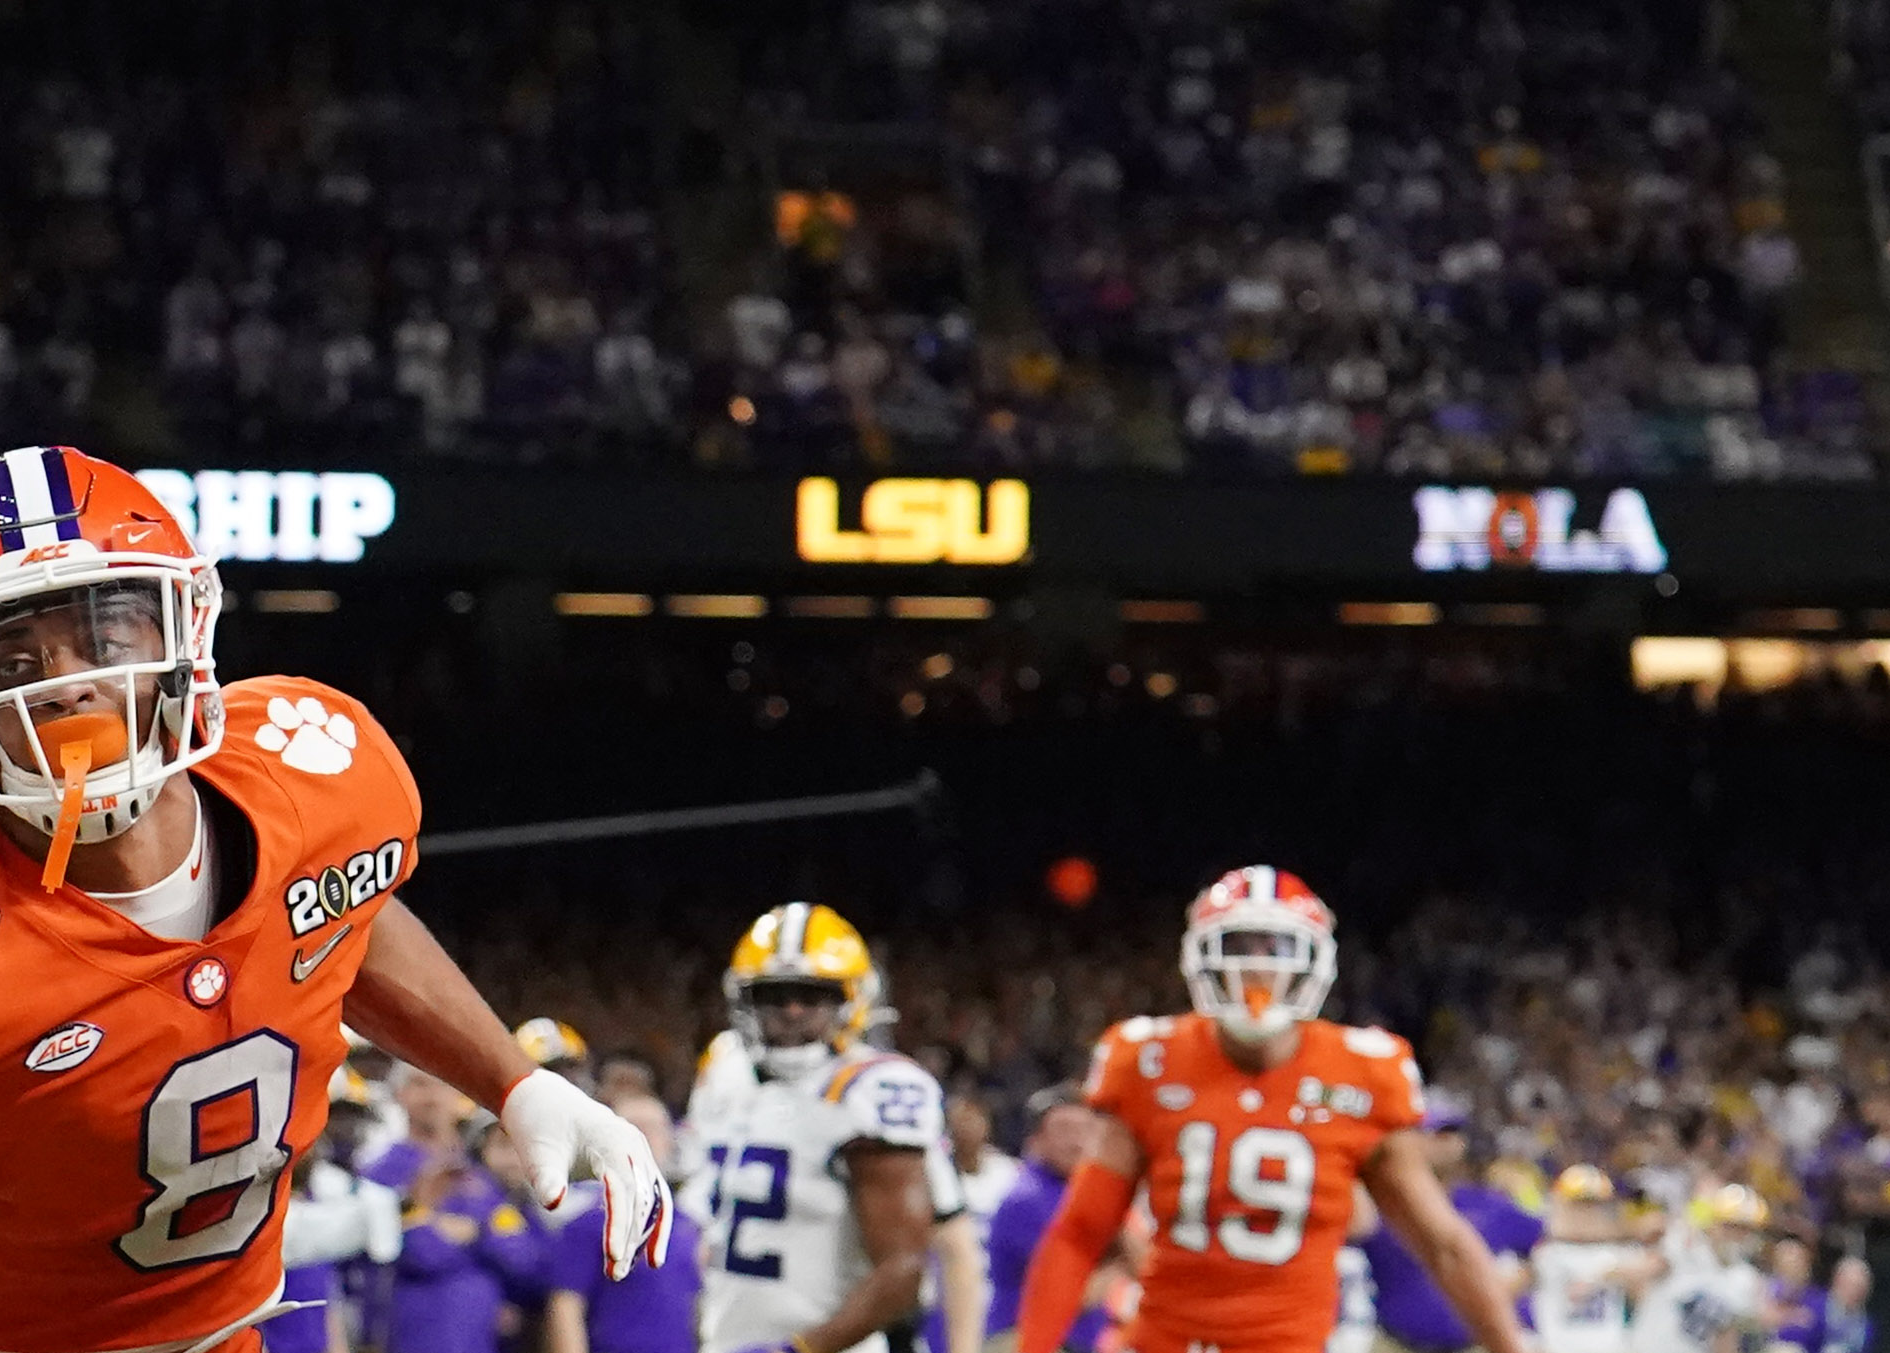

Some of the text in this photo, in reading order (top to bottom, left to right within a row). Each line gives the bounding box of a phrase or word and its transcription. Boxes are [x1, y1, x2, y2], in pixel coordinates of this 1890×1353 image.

[20, 543, 71, 567] ACC
[795, 475, 1031, 566] LSU
[1412, 485, 1669, 574] NOLA
[35, 1026, 91, 1065] ACC
[111, 1026, 300, 1273] 8
[1168, 1120, 1316, 1266] 19
